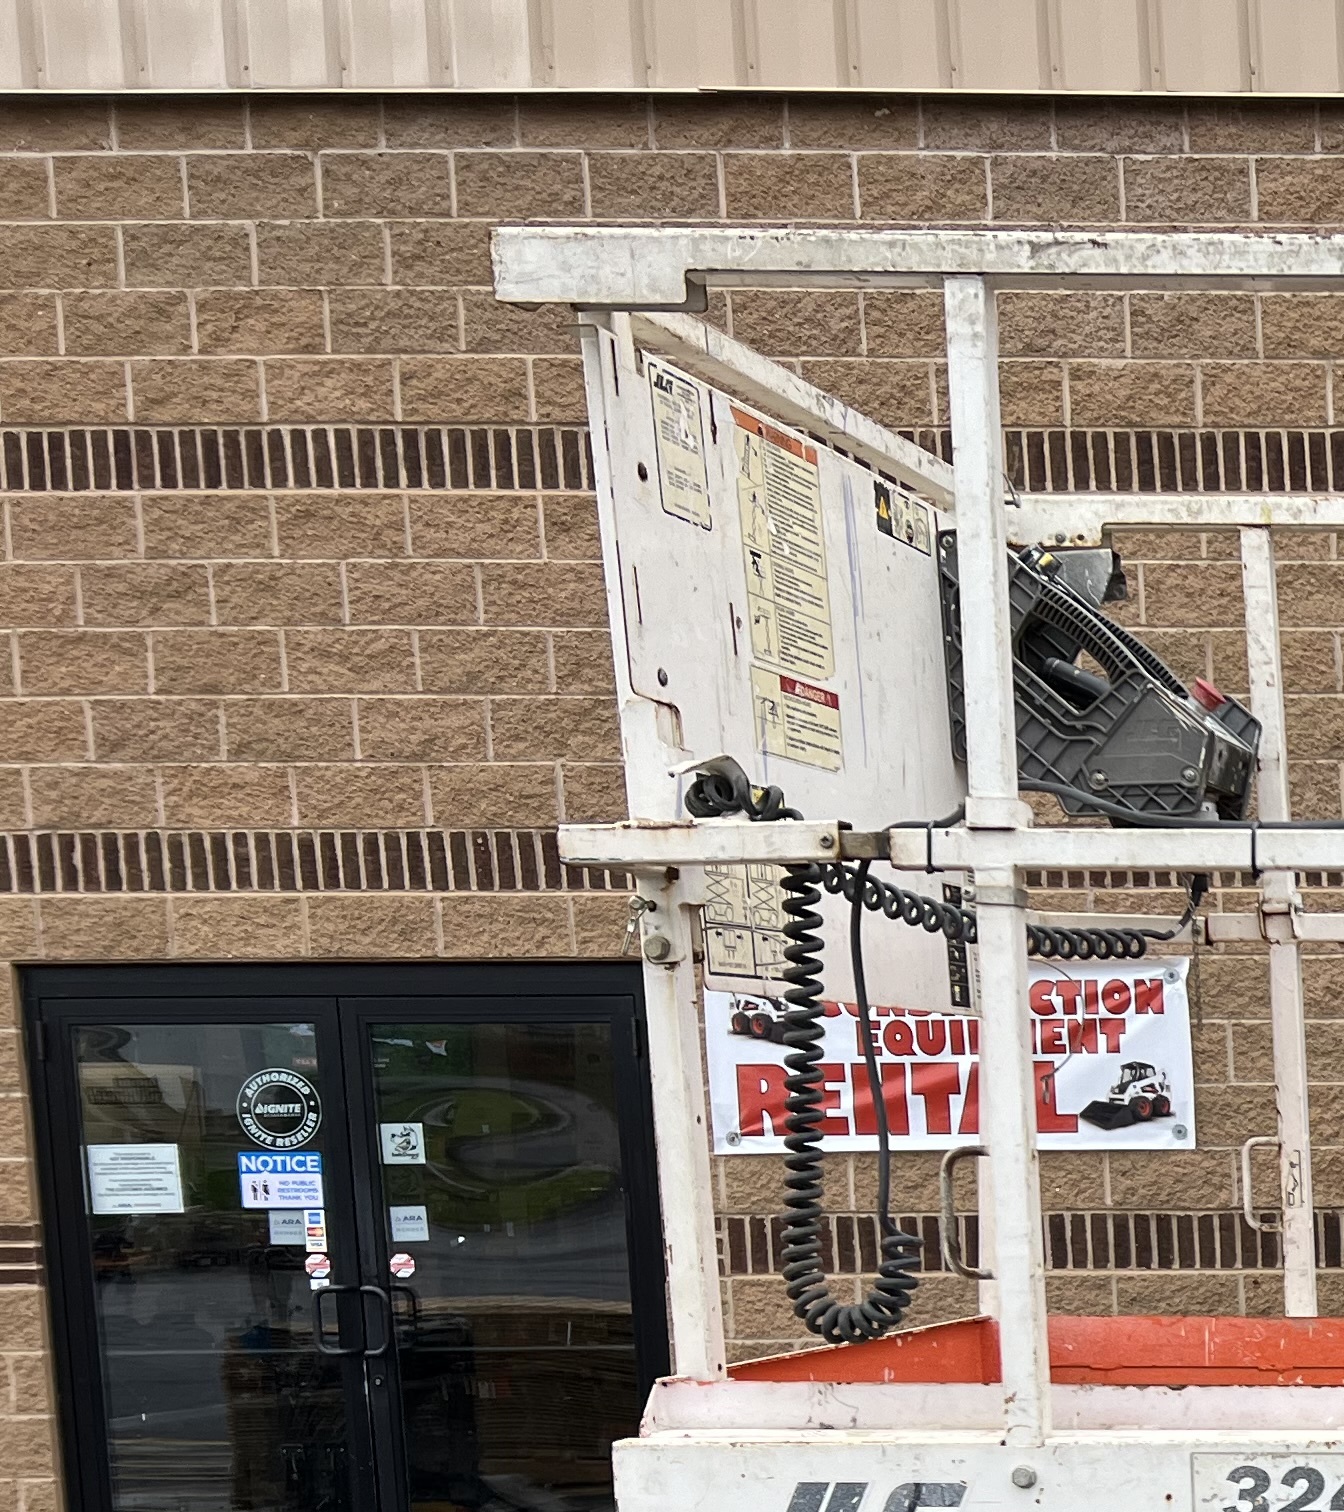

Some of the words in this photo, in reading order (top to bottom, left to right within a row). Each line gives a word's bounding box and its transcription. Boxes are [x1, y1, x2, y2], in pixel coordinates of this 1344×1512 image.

[855, 1018, 1126, 1056] EQUIENT
[244, 1072, 311, 1098] AUTHORIZED
[736, 1061, 1079, 1136] RENTL
[263, 1103, 301, 1113] IGNITE
[241, 1113, 274, 1145] IGNITE
[275, 1112, 318, 1147] RESELLER
[240, 1155, 320, 1172] NOTICE
